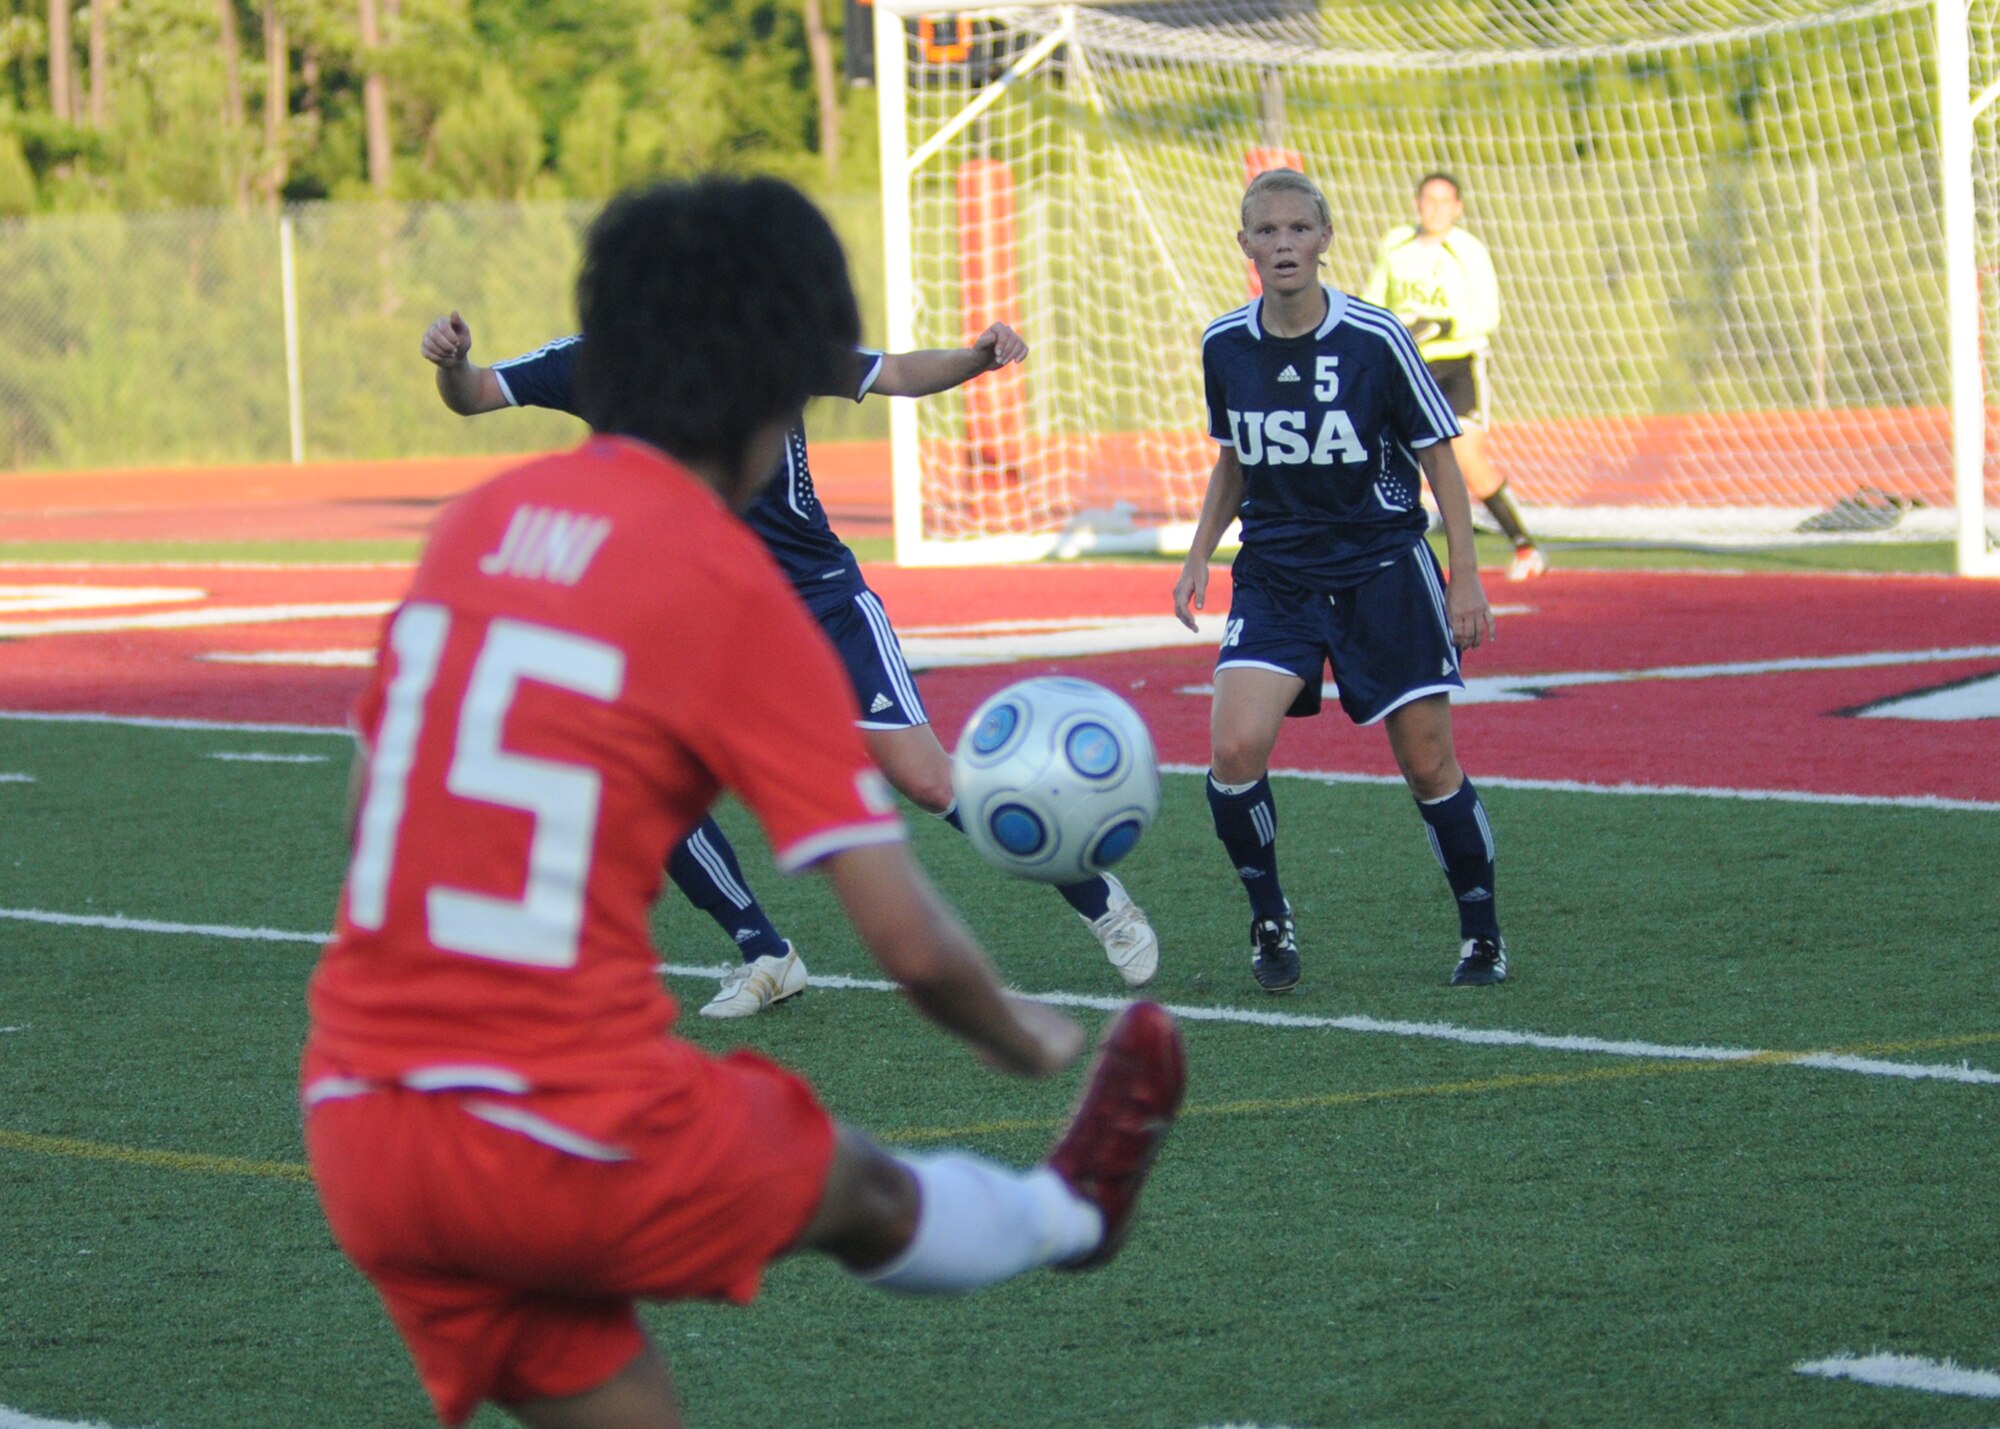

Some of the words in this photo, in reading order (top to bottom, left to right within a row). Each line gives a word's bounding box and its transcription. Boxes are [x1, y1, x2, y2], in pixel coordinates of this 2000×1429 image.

[1314, 355, 1340, 402] 5
[1226, 408, 1368, 466] USA
[348, 601, 627, 969] 15
